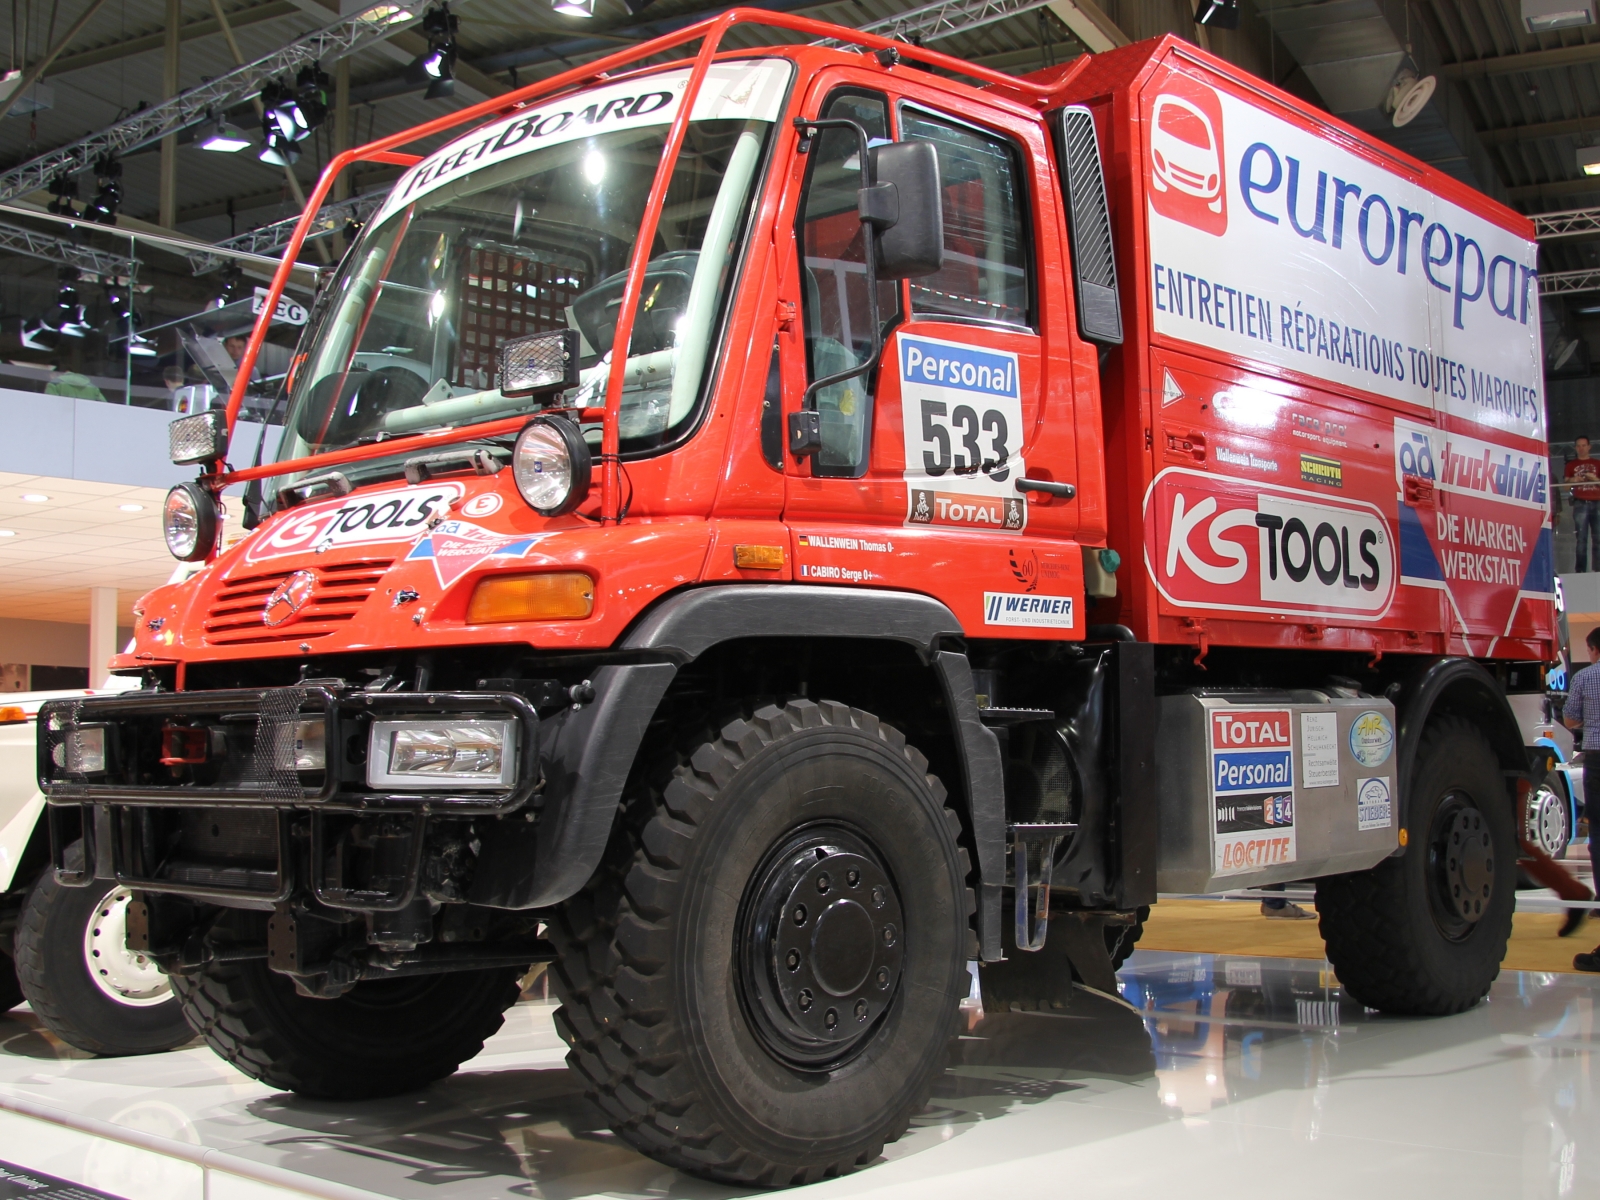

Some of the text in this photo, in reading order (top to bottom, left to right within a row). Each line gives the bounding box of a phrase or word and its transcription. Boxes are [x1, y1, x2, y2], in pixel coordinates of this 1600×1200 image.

[1154, 263, 1538, 424] ENTRETIEN RÉPARATIONS TOUTES MARQUES
[906, 346, 1012, 393] Personal
[920, 398, 1010, 483] 533
[1301, 474, 1342, 487] RACING
[325, 494, 444, 535] TOOLS
[935, 497, 1003, 524] TOTAL
[808, 535, 859, 550] WALLENWEIN
[859, 539, 887, 552] Thomas
[1166, 492, 1380, 592] KS TOOLS
[1436, 511, 1527, 554] DIE MARKEN-
[810, 565, 840, 579] CABIRO
[841, 567, 862, 583] Serge
[1022, 559, 1033, 577] 60
[1441, 548, 1521, 587] WERKSTATT
[1005, 596, 1072, 615] WERNER
[1215, 715, 1288, 745] TOTAL
[1217, 755, 1289, 787] Personal
[1266, 802, 1292, 821] 2 3 4
[1222, 836, 1291, 870] LOCTITE
